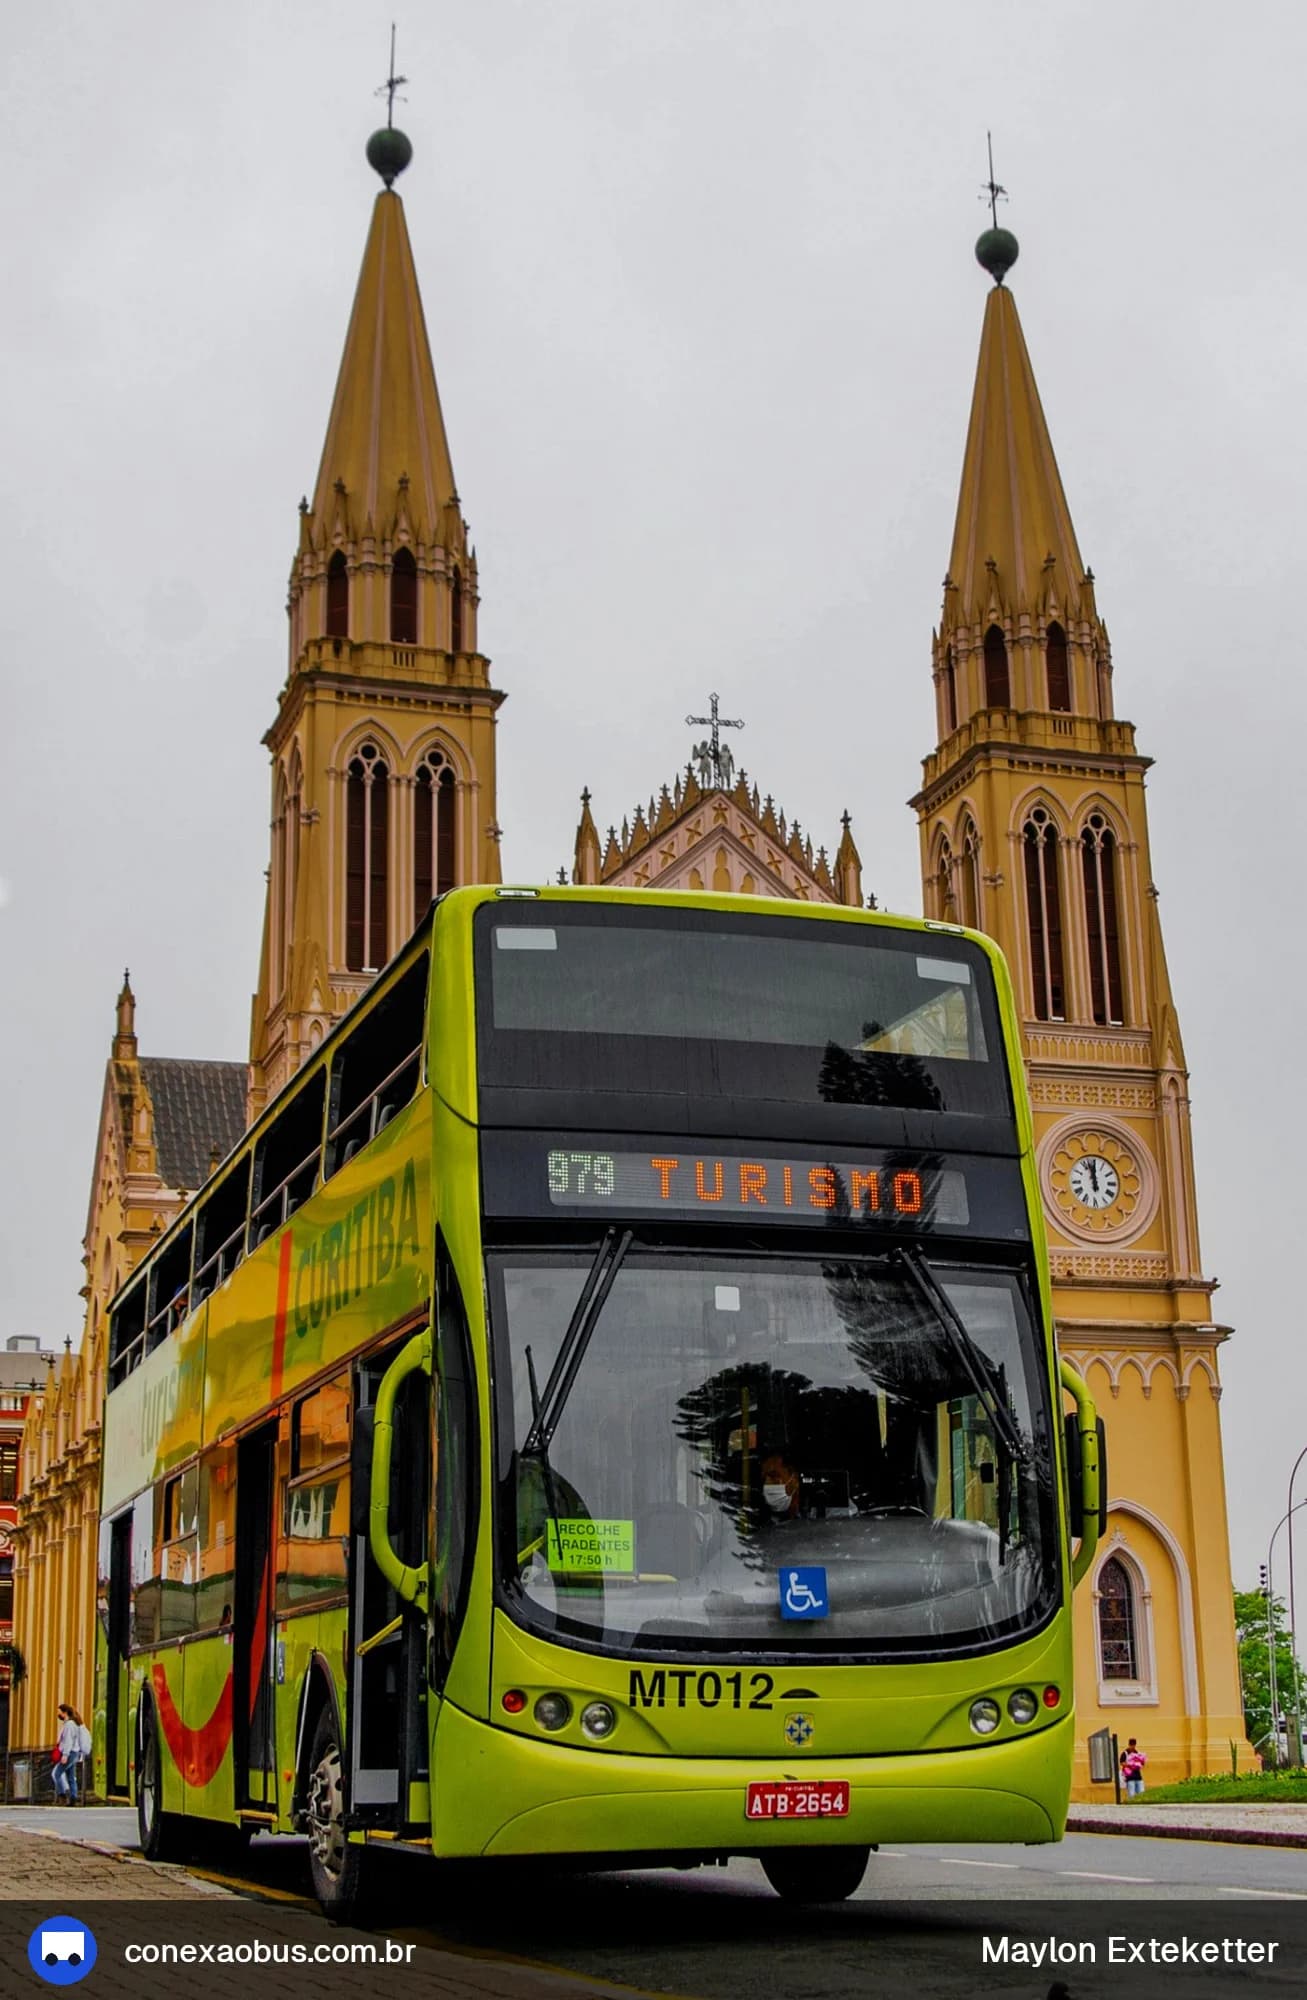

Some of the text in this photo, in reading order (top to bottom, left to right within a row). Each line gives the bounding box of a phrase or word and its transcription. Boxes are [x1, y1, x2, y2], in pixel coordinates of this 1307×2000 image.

[547, 1151, 922, 1213] 979 TURISMO
[294, 1157, 420, 1338] CURITIBA
[559, 1523, 621, 1536] RECOLHE
[550, 1539, 631, 1552] TRADENTES
[569, 1554, 614, 1566] 17:50 h
[629, 1669, 774, 1711] MT012
